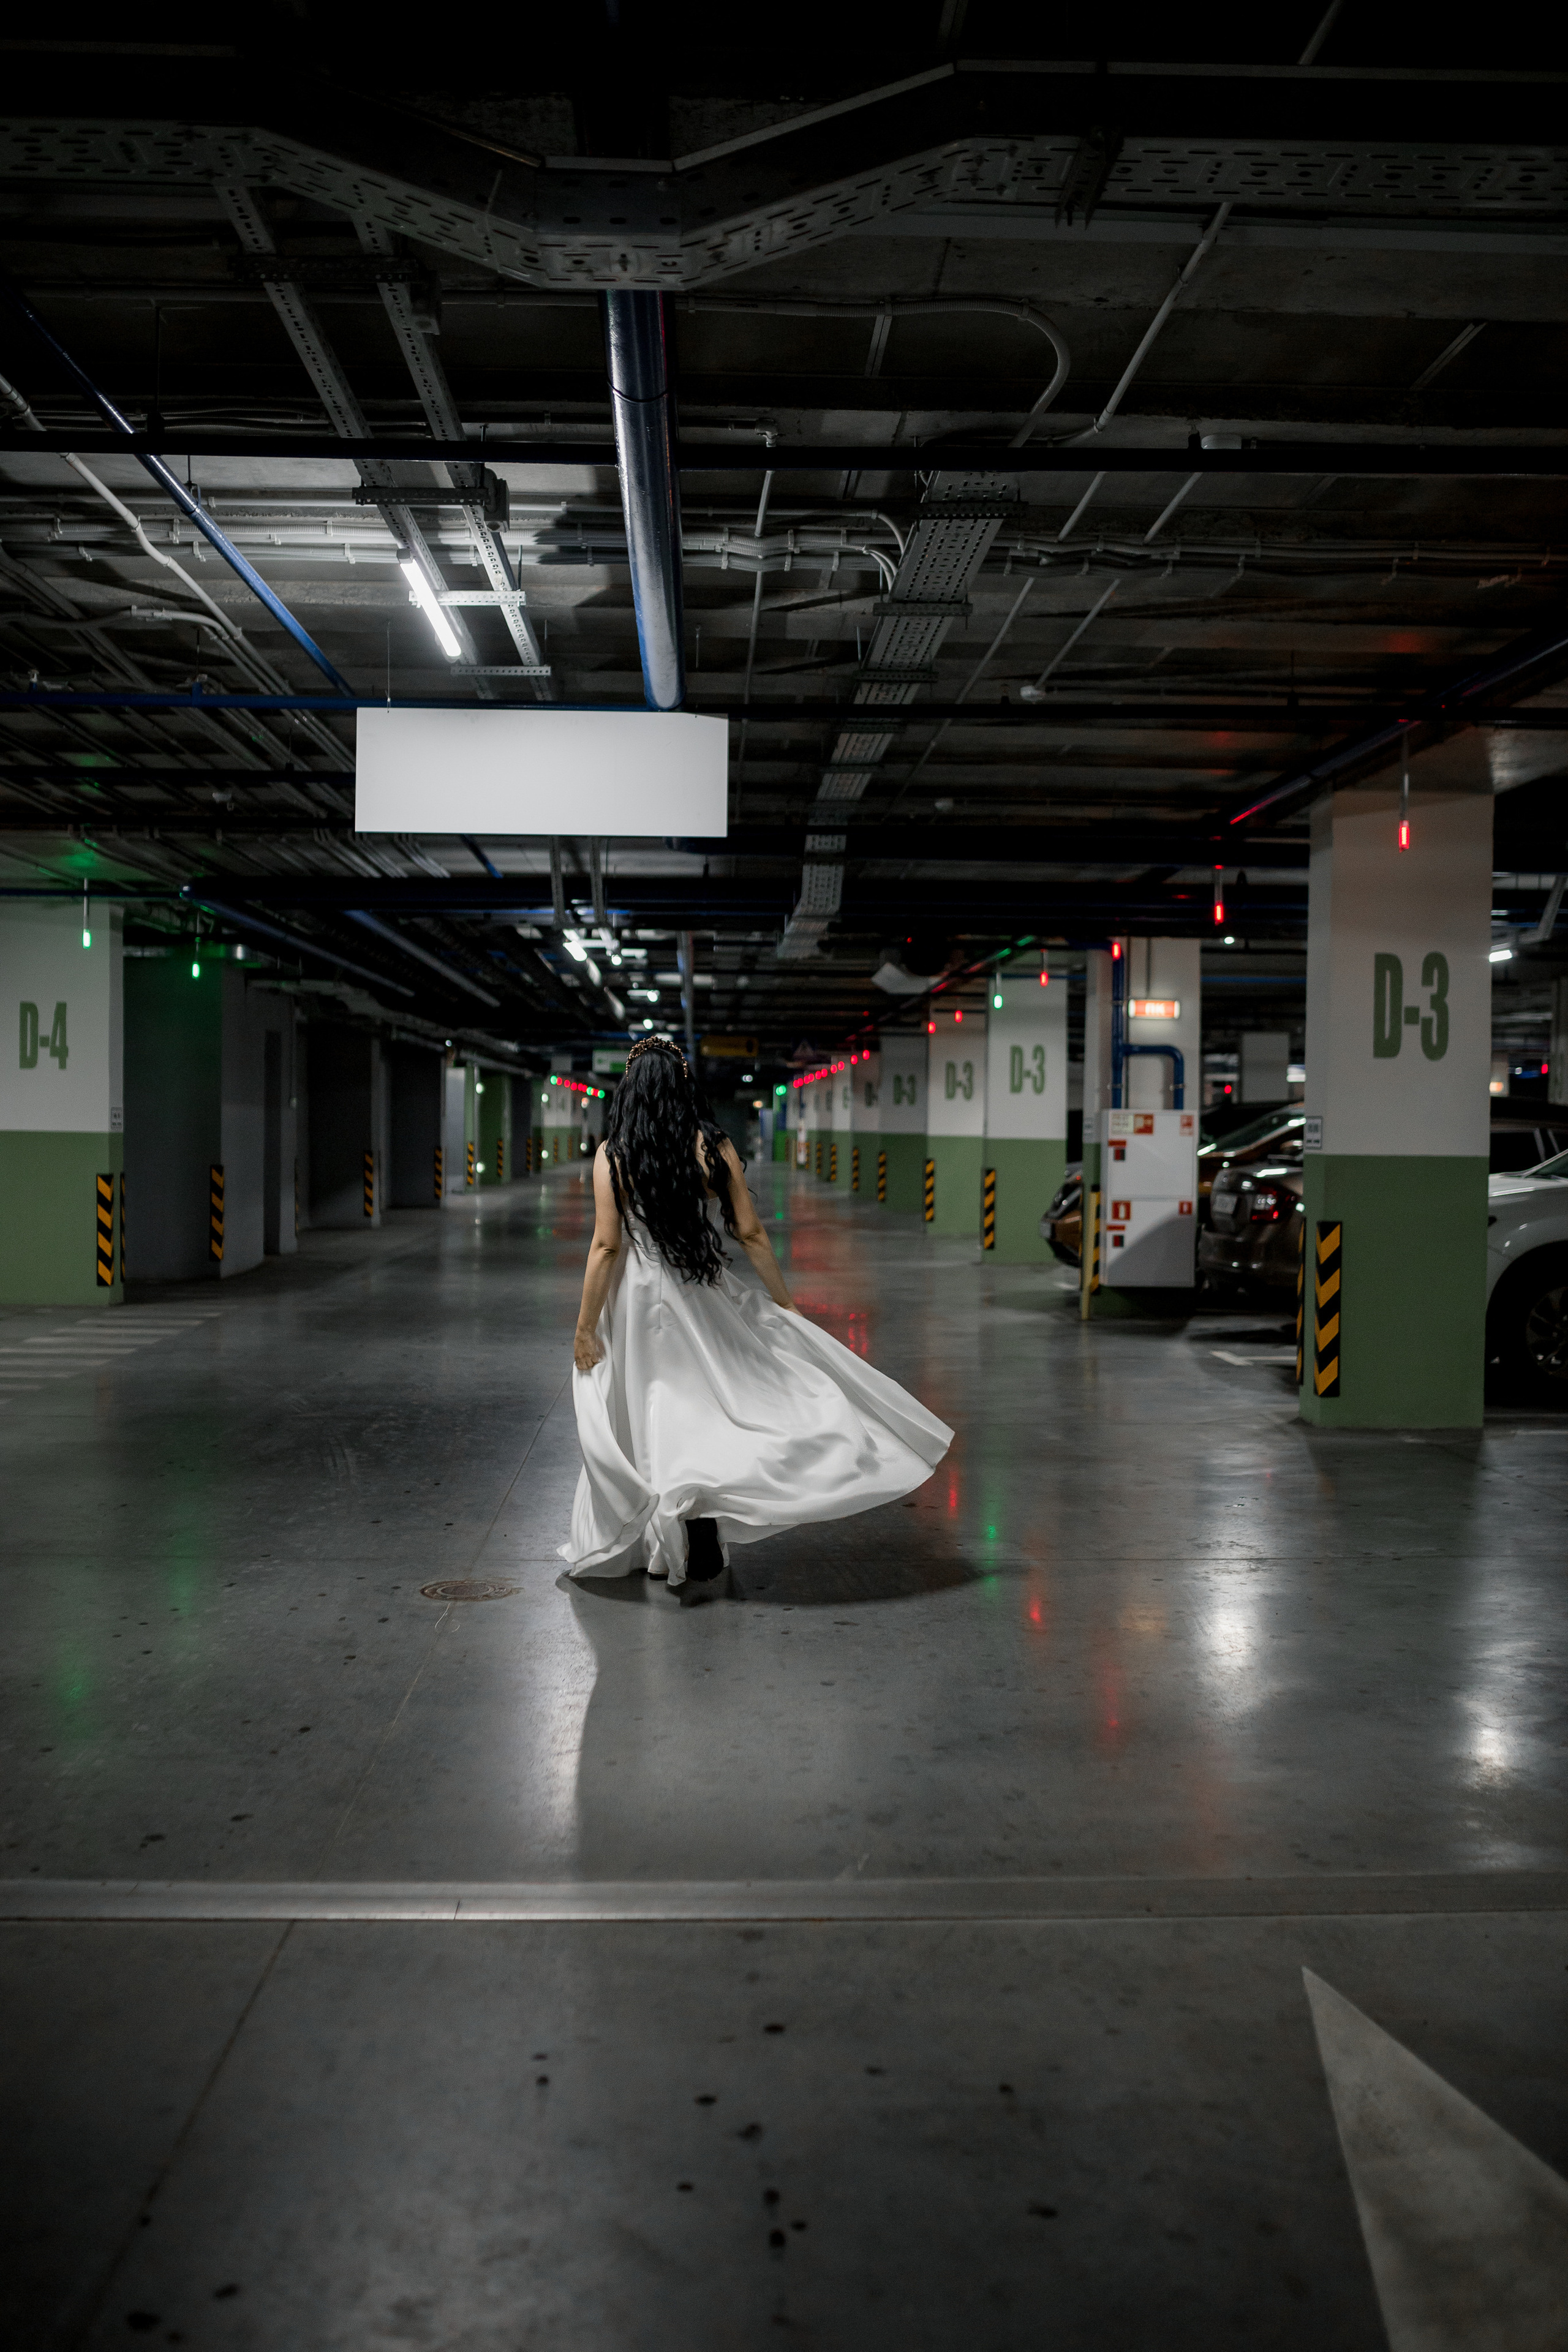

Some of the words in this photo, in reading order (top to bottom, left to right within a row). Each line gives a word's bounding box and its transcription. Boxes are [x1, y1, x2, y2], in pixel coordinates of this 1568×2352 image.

[1373, 951, 1449, 1060] D-3
[20, 1002, 69, 1069] D-4
[946, 1061, 974, 1100] D-3
[1010, 1044, 1046, 1094] D-3
